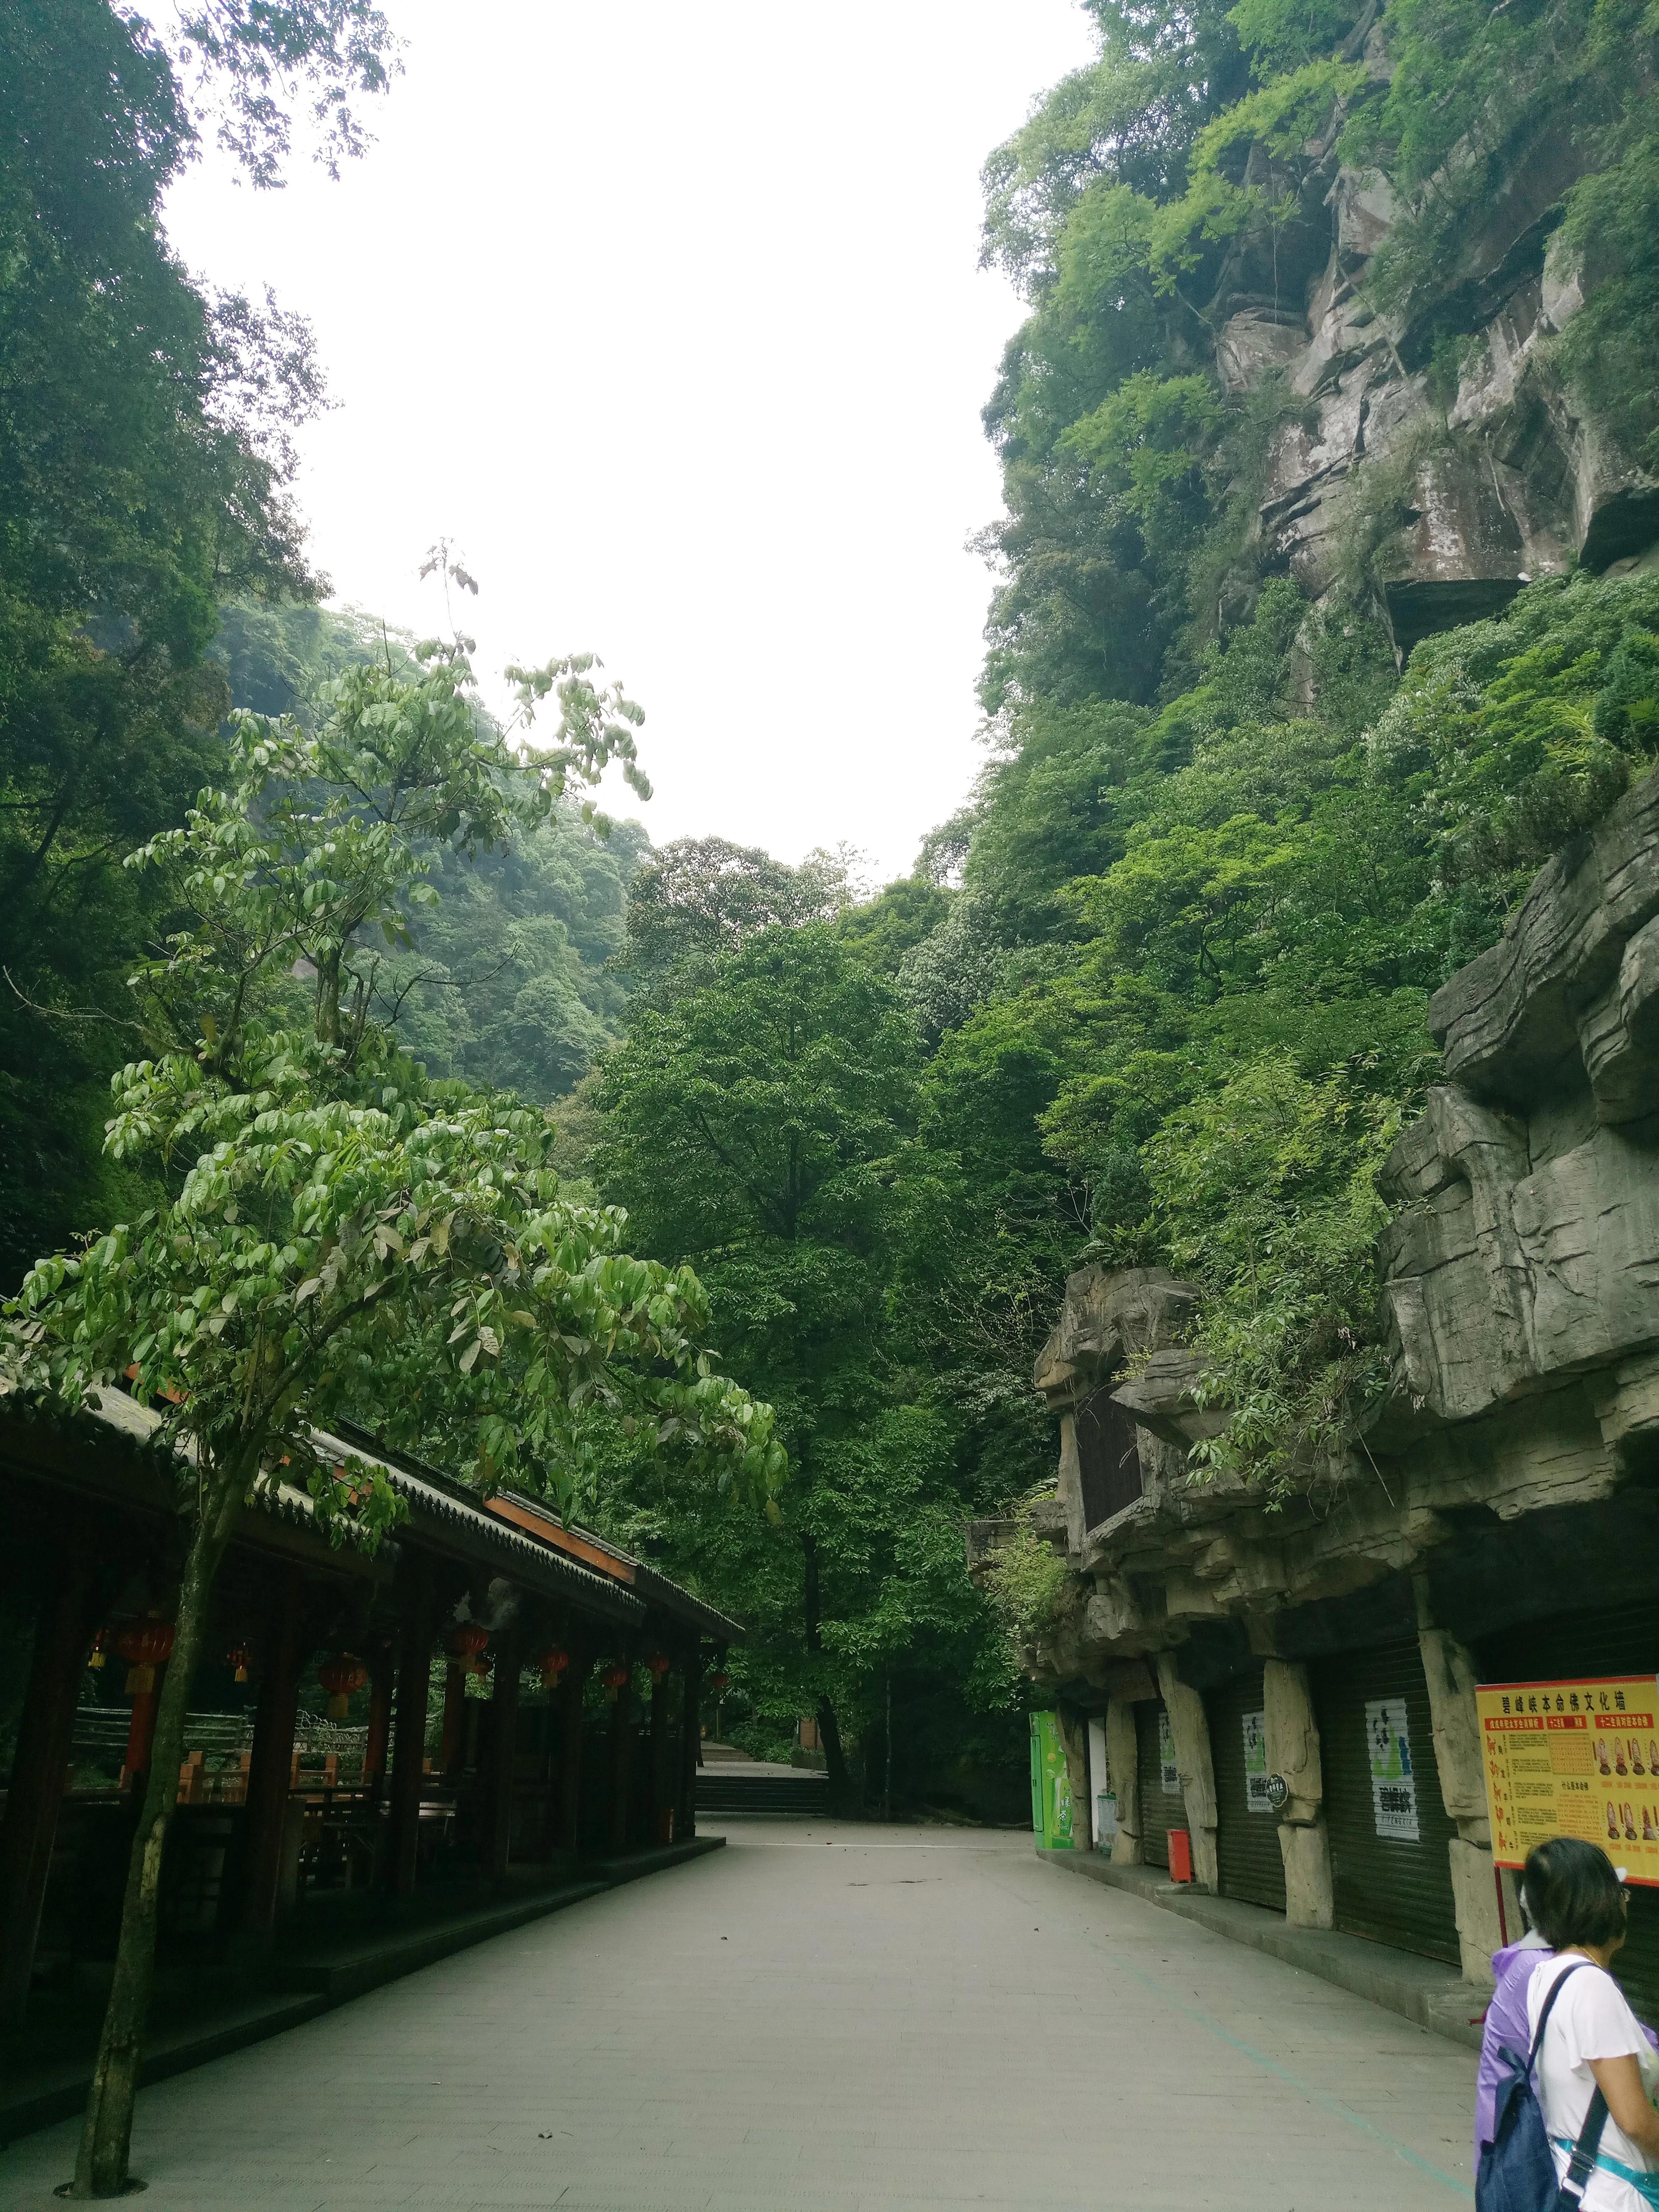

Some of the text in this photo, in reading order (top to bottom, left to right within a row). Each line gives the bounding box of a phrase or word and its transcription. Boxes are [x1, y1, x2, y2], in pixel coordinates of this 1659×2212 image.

[1502, 1690, 1626, 1714] 碧峰峡本命佛文化墙
